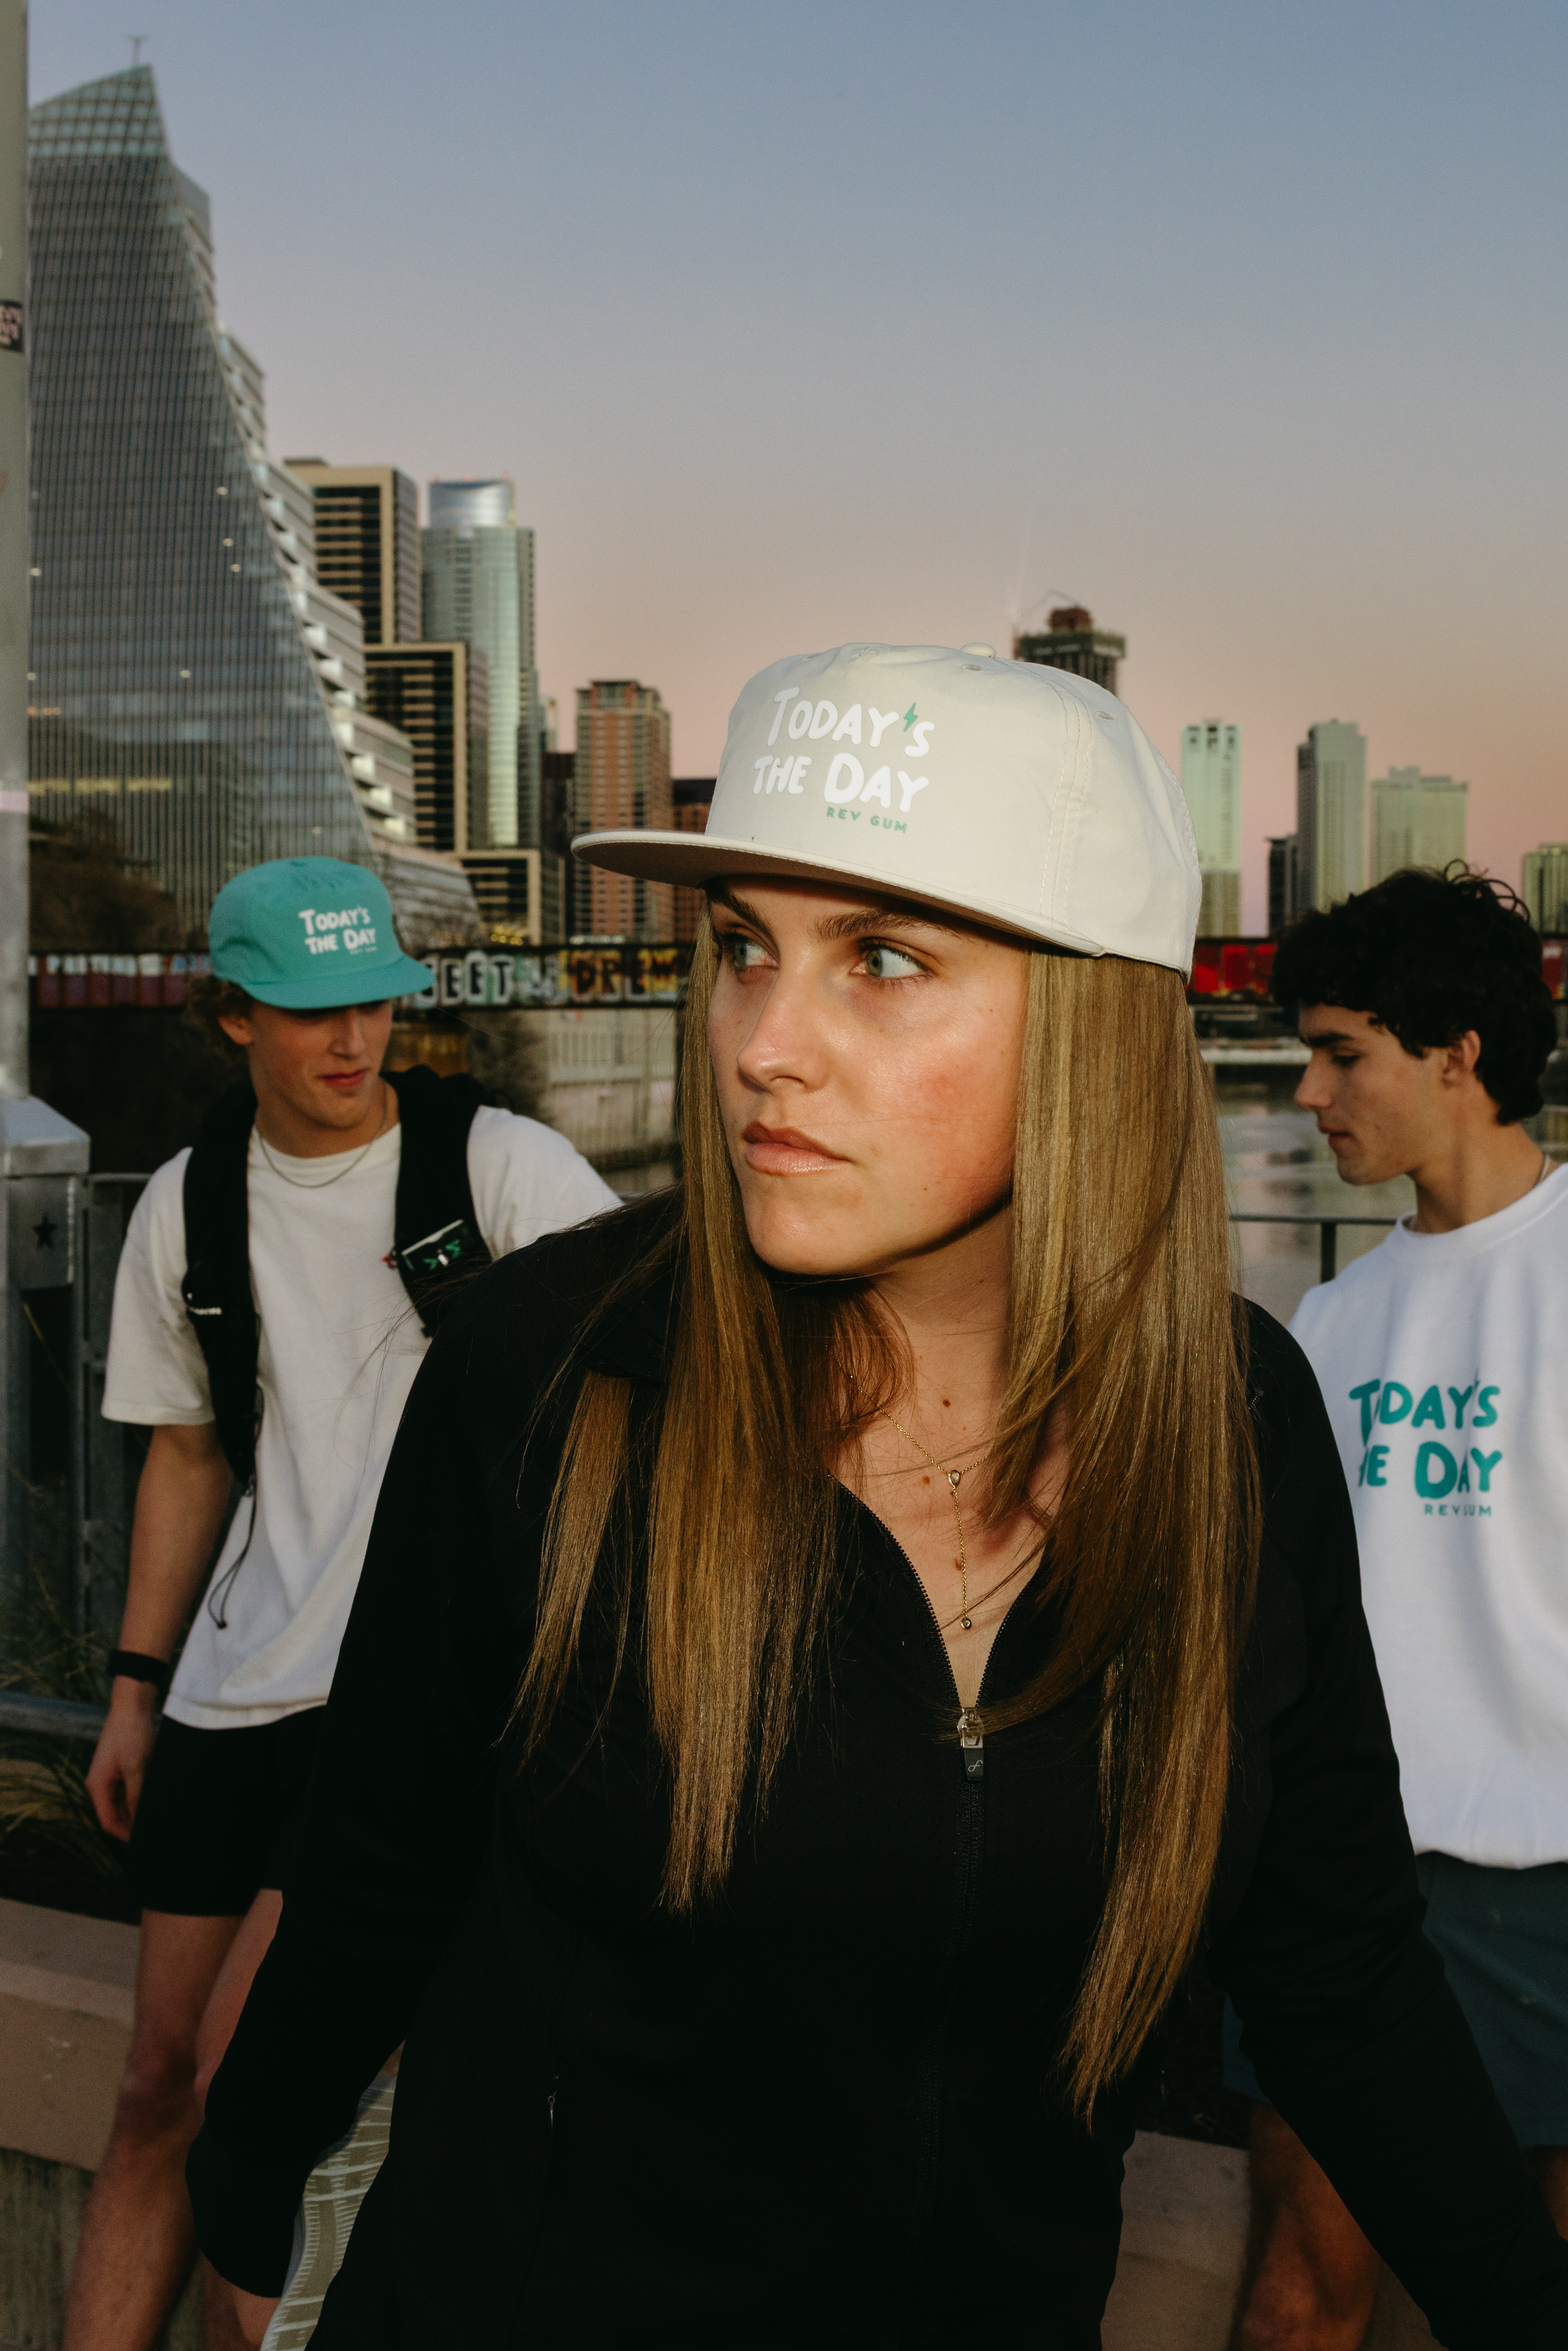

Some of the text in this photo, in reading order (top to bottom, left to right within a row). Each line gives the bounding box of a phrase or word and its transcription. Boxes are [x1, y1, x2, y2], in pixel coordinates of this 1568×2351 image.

[767, 687, 935, 757] TODAY'S
[753, 753, 929, 812] THE DAY
[826, 806, 907, 834] REV GUM
[304, 927, 376, 955] THE DAY
